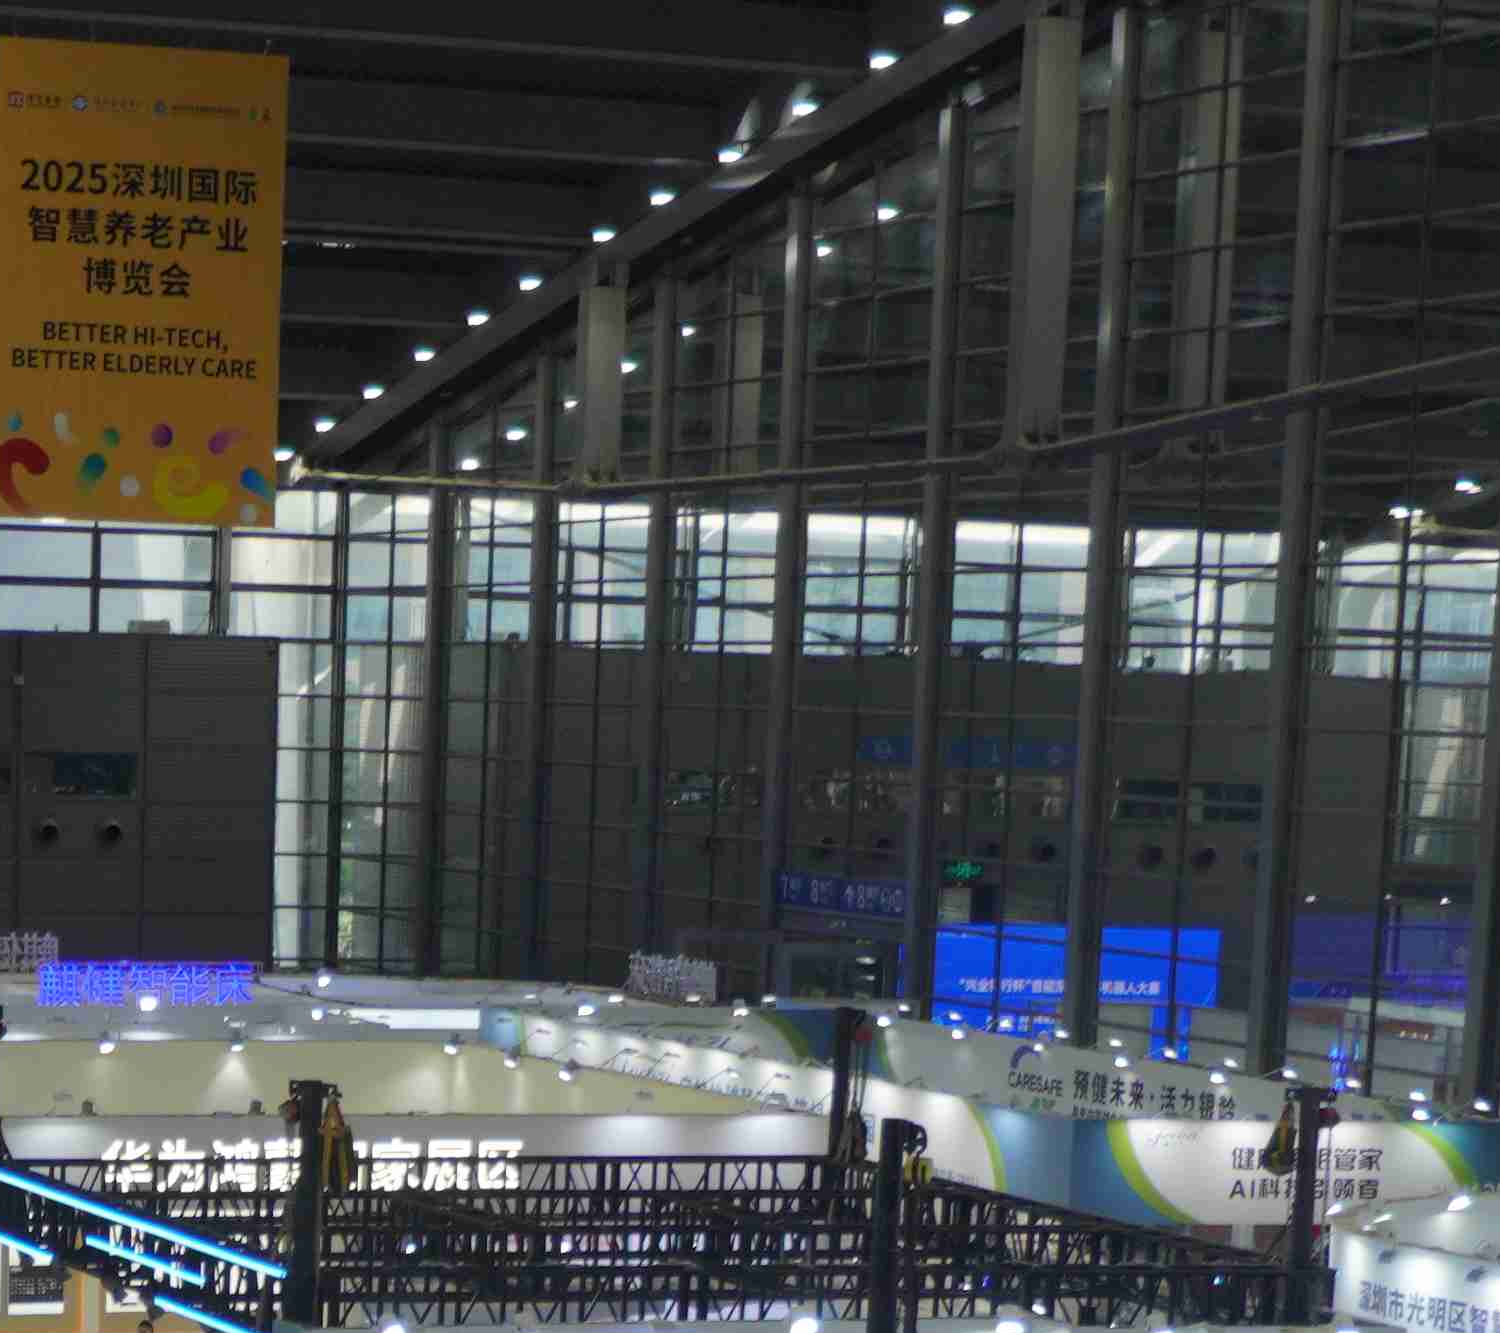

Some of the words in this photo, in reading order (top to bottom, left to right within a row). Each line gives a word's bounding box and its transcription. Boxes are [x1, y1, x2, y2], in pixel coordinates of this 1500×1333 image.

[20, 157, 258, 206] 2025深圳国际
[28, 205, 249, 253] 智慧养老产业
[83, 256, 191, 298] 博览会
[43, 320, 127, 345] BETTER
[134, 326, 229, 354] HI-TECH,
[11, 348, 97, 371] BETTER
[103, 352, 196, 376] ELDERLY
[201, 357, 258, 380] CARE
[102, 1137, 526, 1193] 华为鸿蒙家展区
